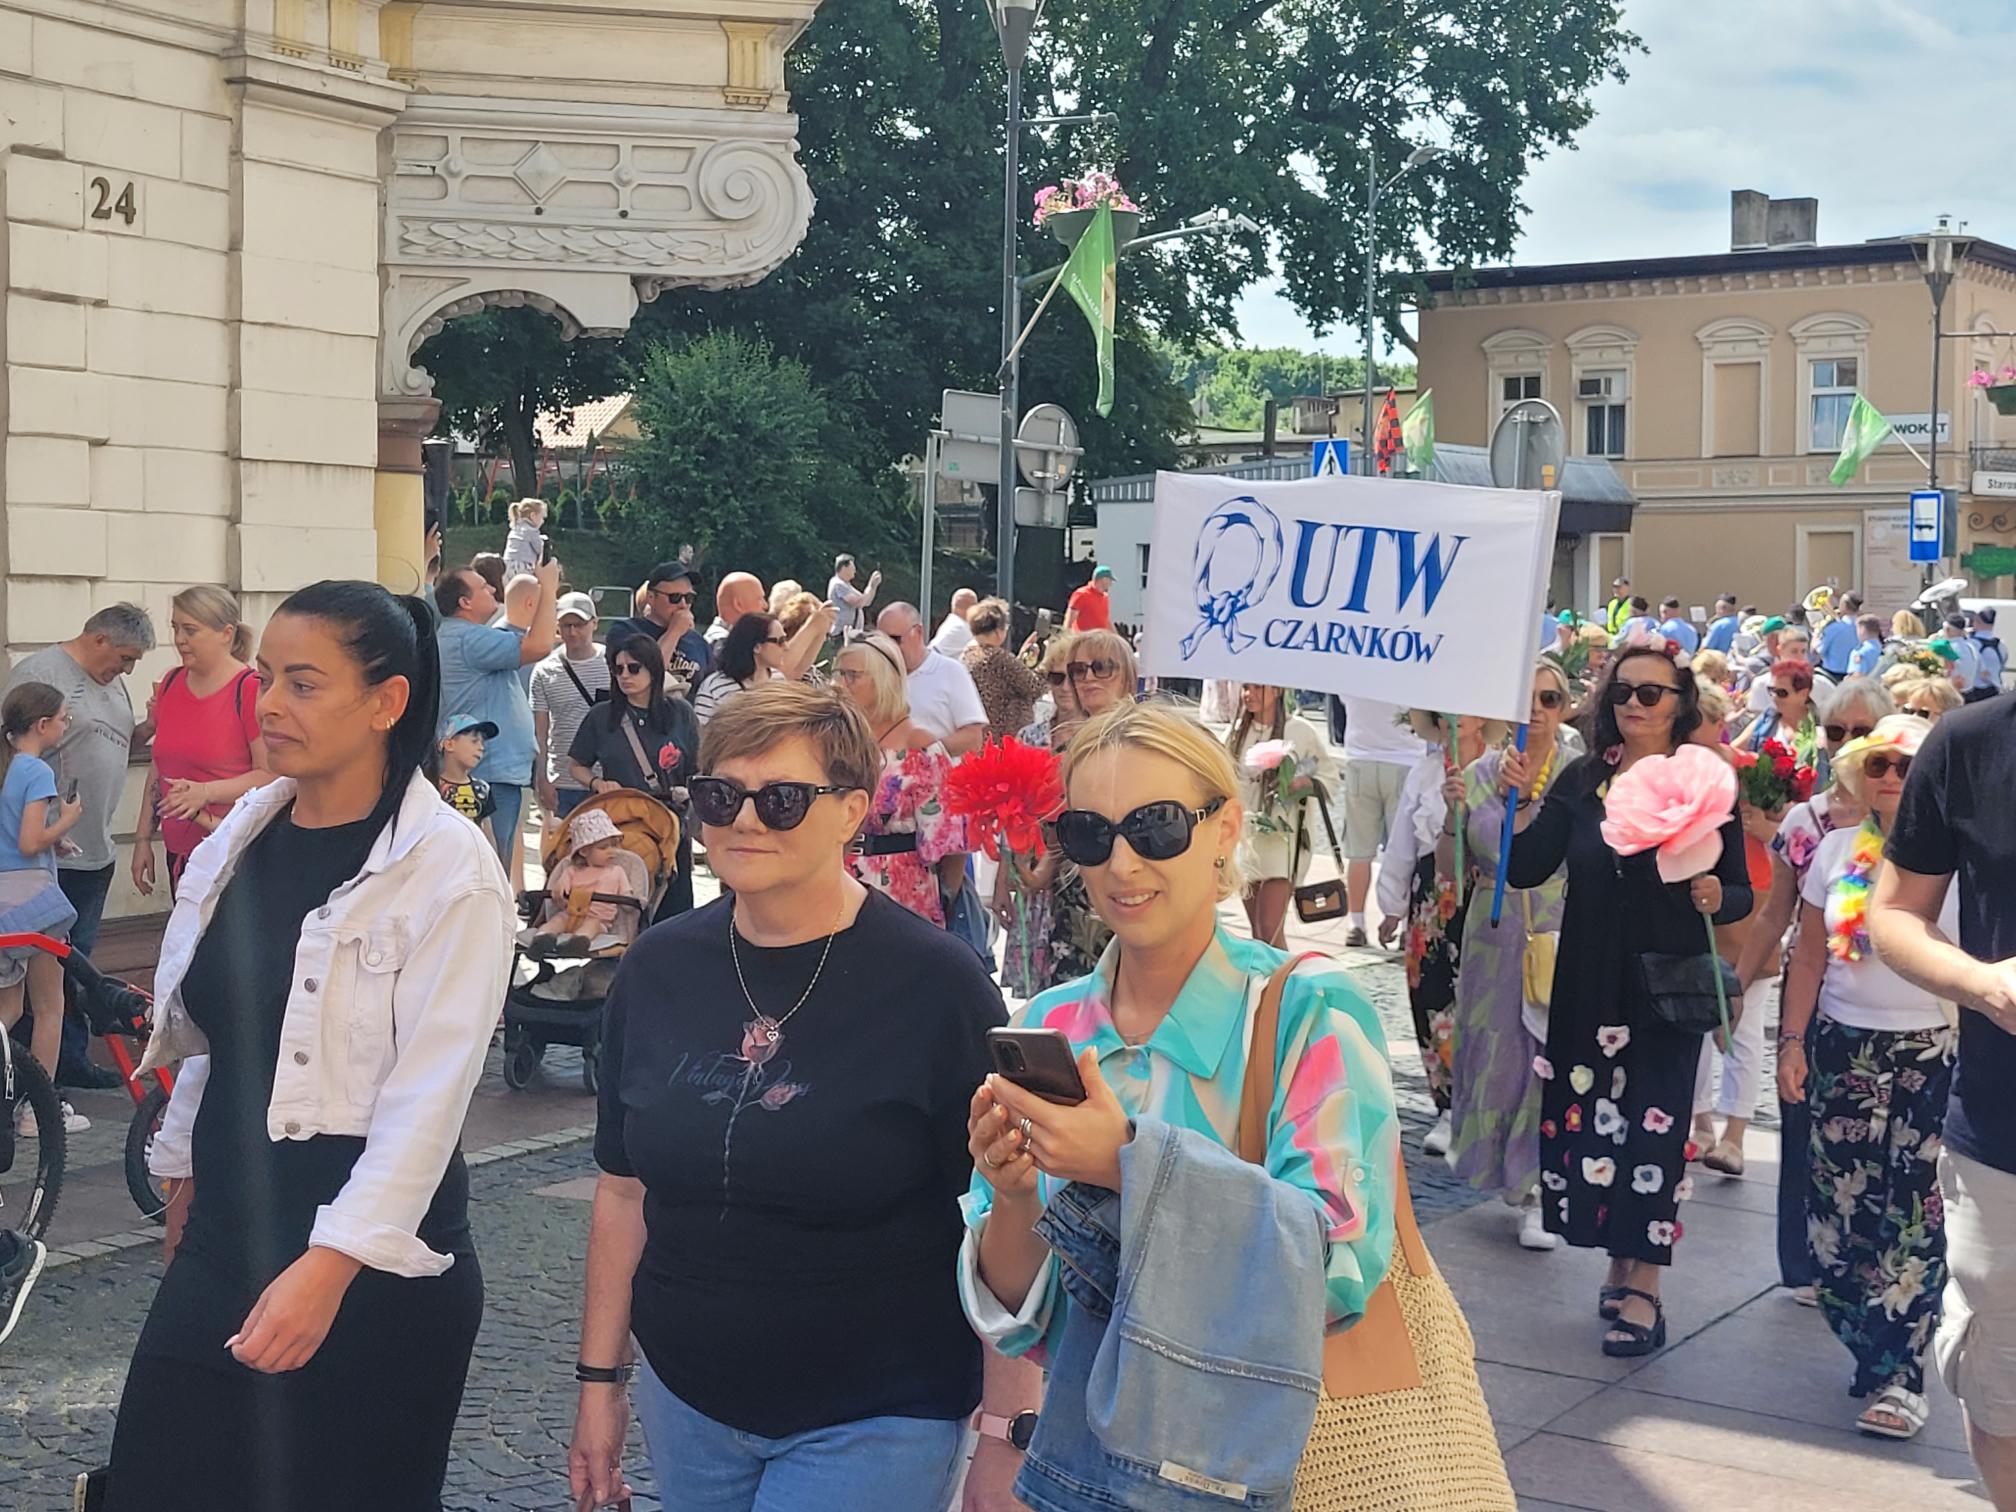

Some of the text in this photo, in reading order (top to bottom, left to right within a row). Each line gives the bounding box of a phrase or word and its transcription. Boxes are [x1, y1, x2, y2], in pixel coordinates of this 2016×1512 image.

[90, 175, 136, 225] 24
[1889, 423, 1947, 434] WOKT
[1290, 519, 1470, 618] UTW
[1264, 618, 1443, 663] CZARNKÓW
